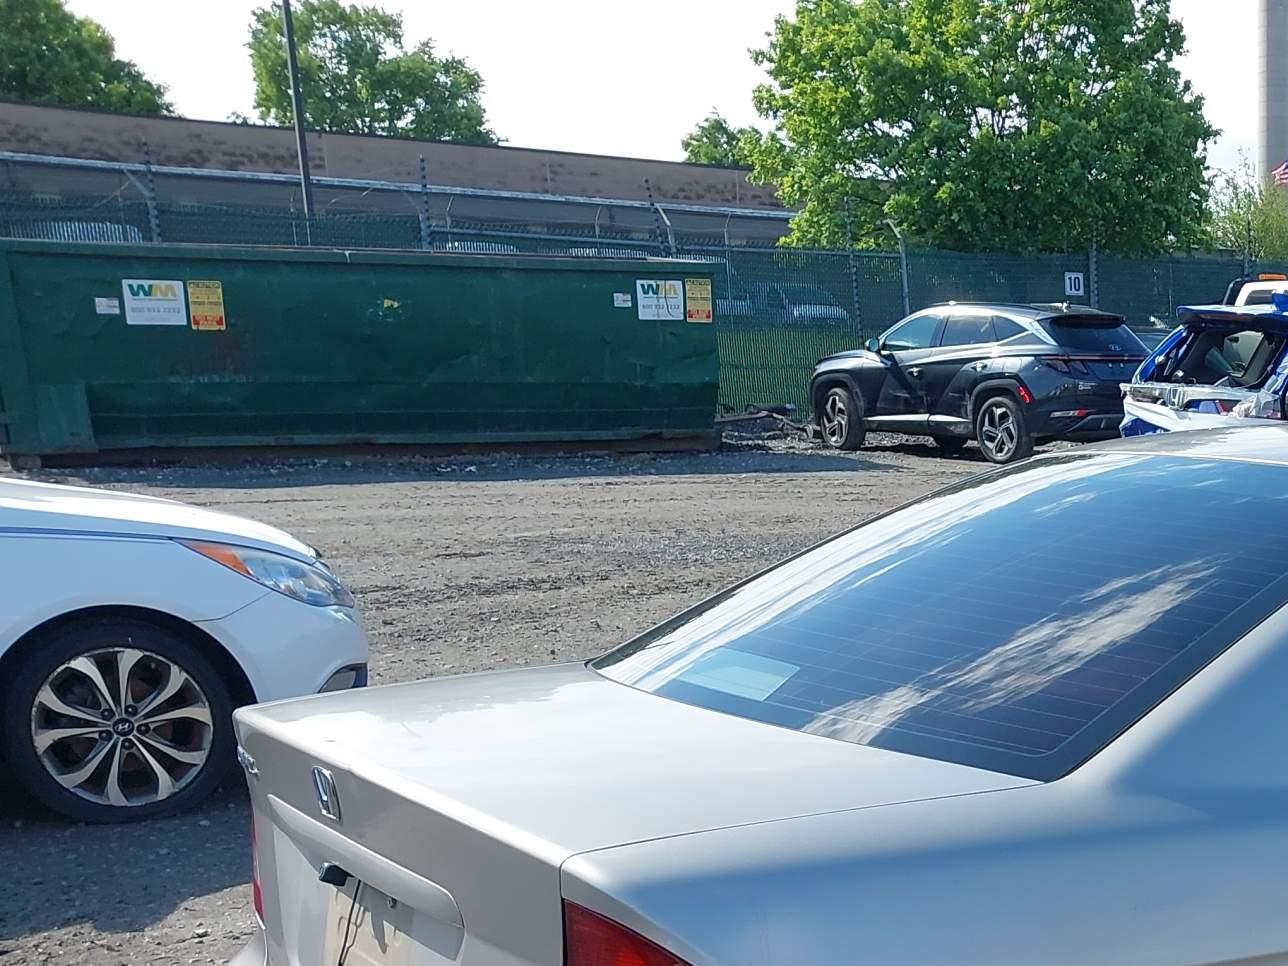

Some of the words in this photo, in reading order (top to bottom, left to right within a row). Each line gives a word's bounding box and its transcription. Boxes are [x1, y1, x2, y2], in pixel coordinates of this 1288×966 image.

[128, 284, 177, 297] WM
[640, 284, 678, 296] WM
[1067, 276, 1081, 292] 10
